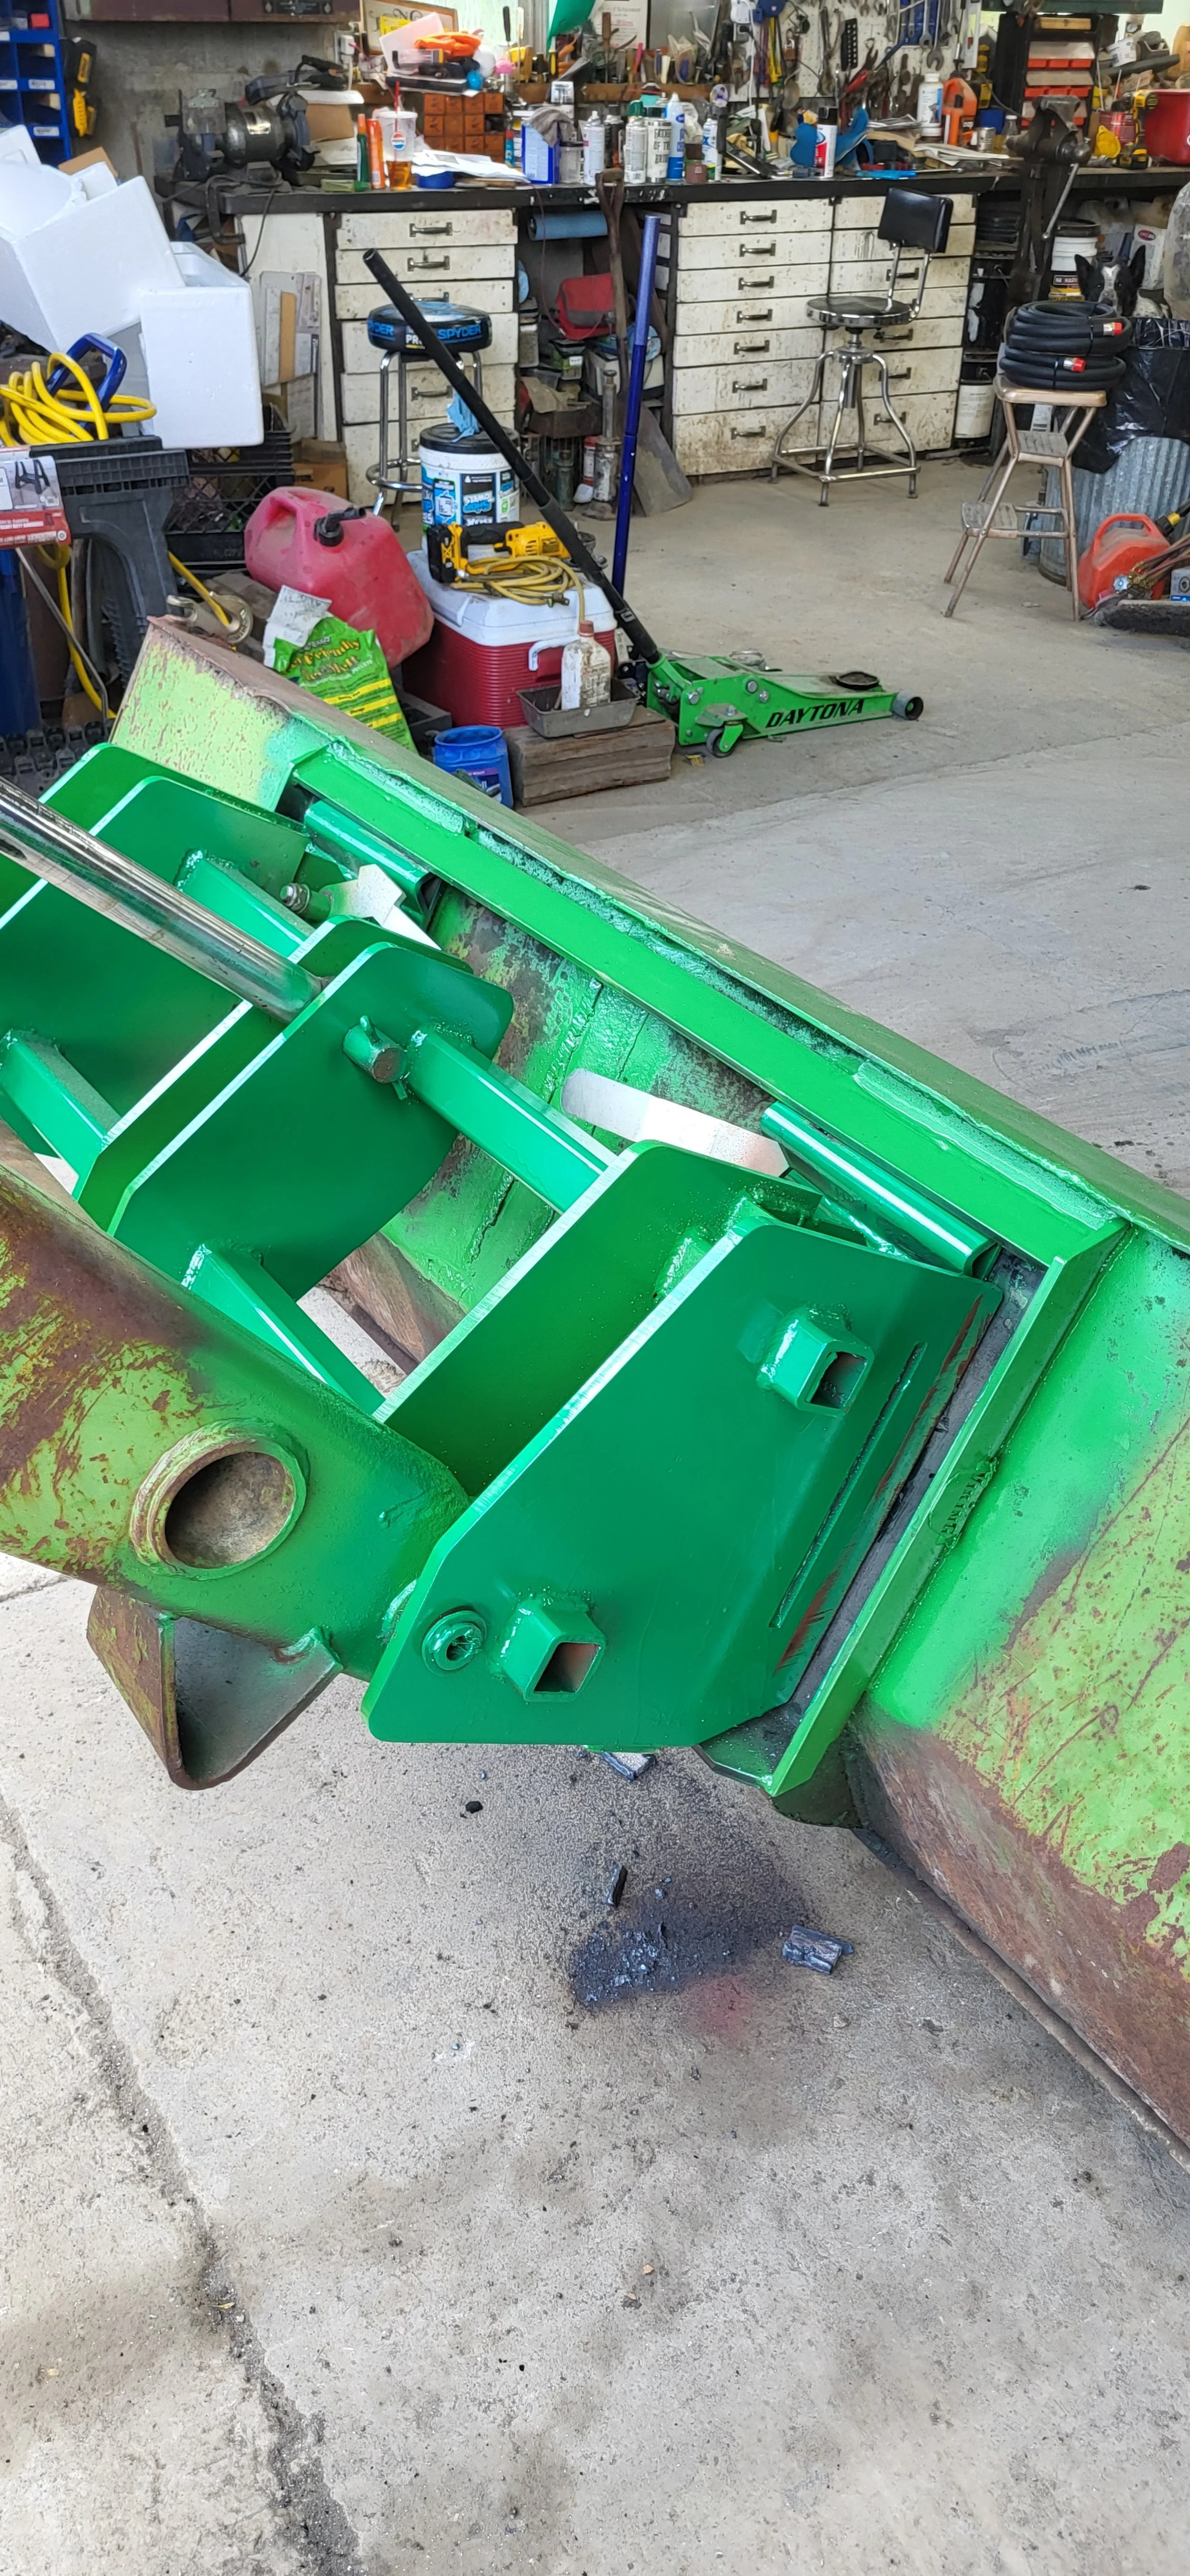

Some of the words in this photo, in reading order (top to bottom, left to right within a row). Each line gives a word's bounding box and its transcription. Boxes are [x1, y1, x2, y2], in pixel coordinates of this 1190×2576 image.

[437, 324, 482, 339] SPYDER
[765, 698, 865, 729] DAYTONA
[941, 1472, 986, 1534] VIKING
